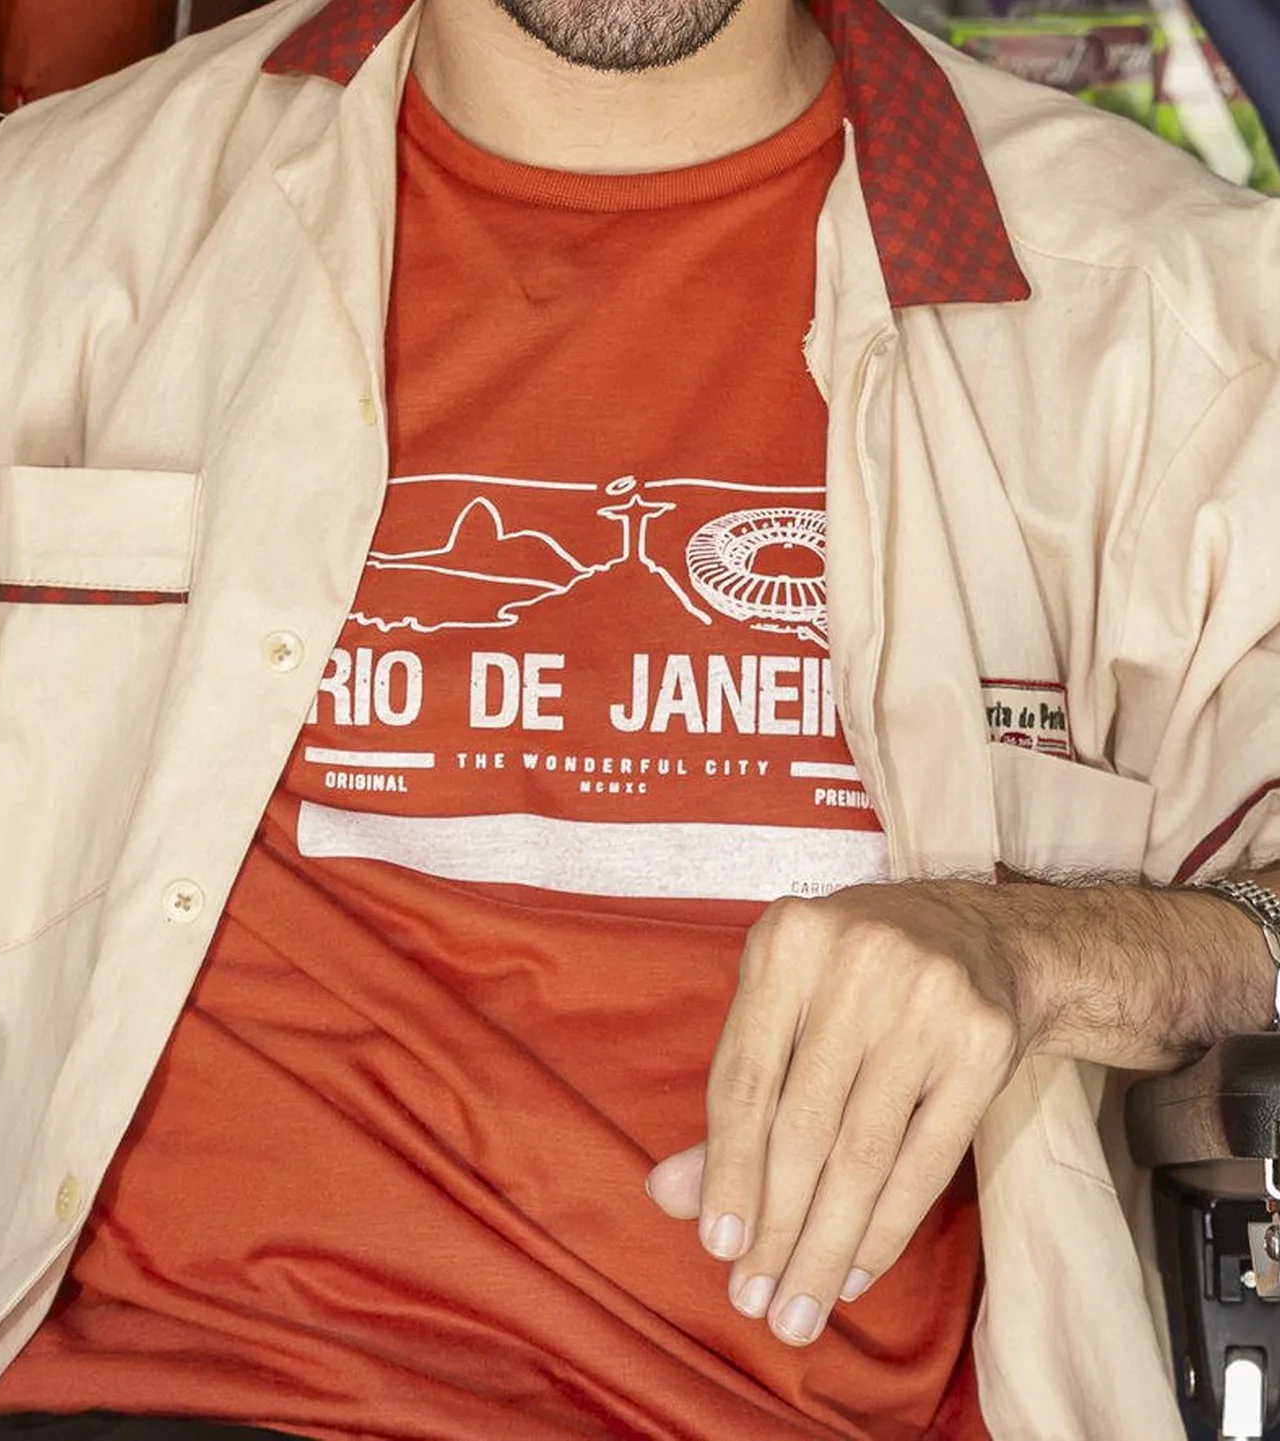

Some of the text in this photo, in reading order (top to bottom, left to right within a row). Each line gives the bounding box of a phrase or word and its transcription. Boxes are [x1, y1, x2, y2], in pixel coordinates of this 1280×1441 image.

[303, 647, 424, 727] RIO
[469, 651, 566, 731] DE
[456, 752, 769, 777] THE WONDERFUL CITY
[324, 770, 409, 793] ORIGINAL
[579, 781, 648, 795] MCMXC
[814, 788, 874, 810] PREMIU
